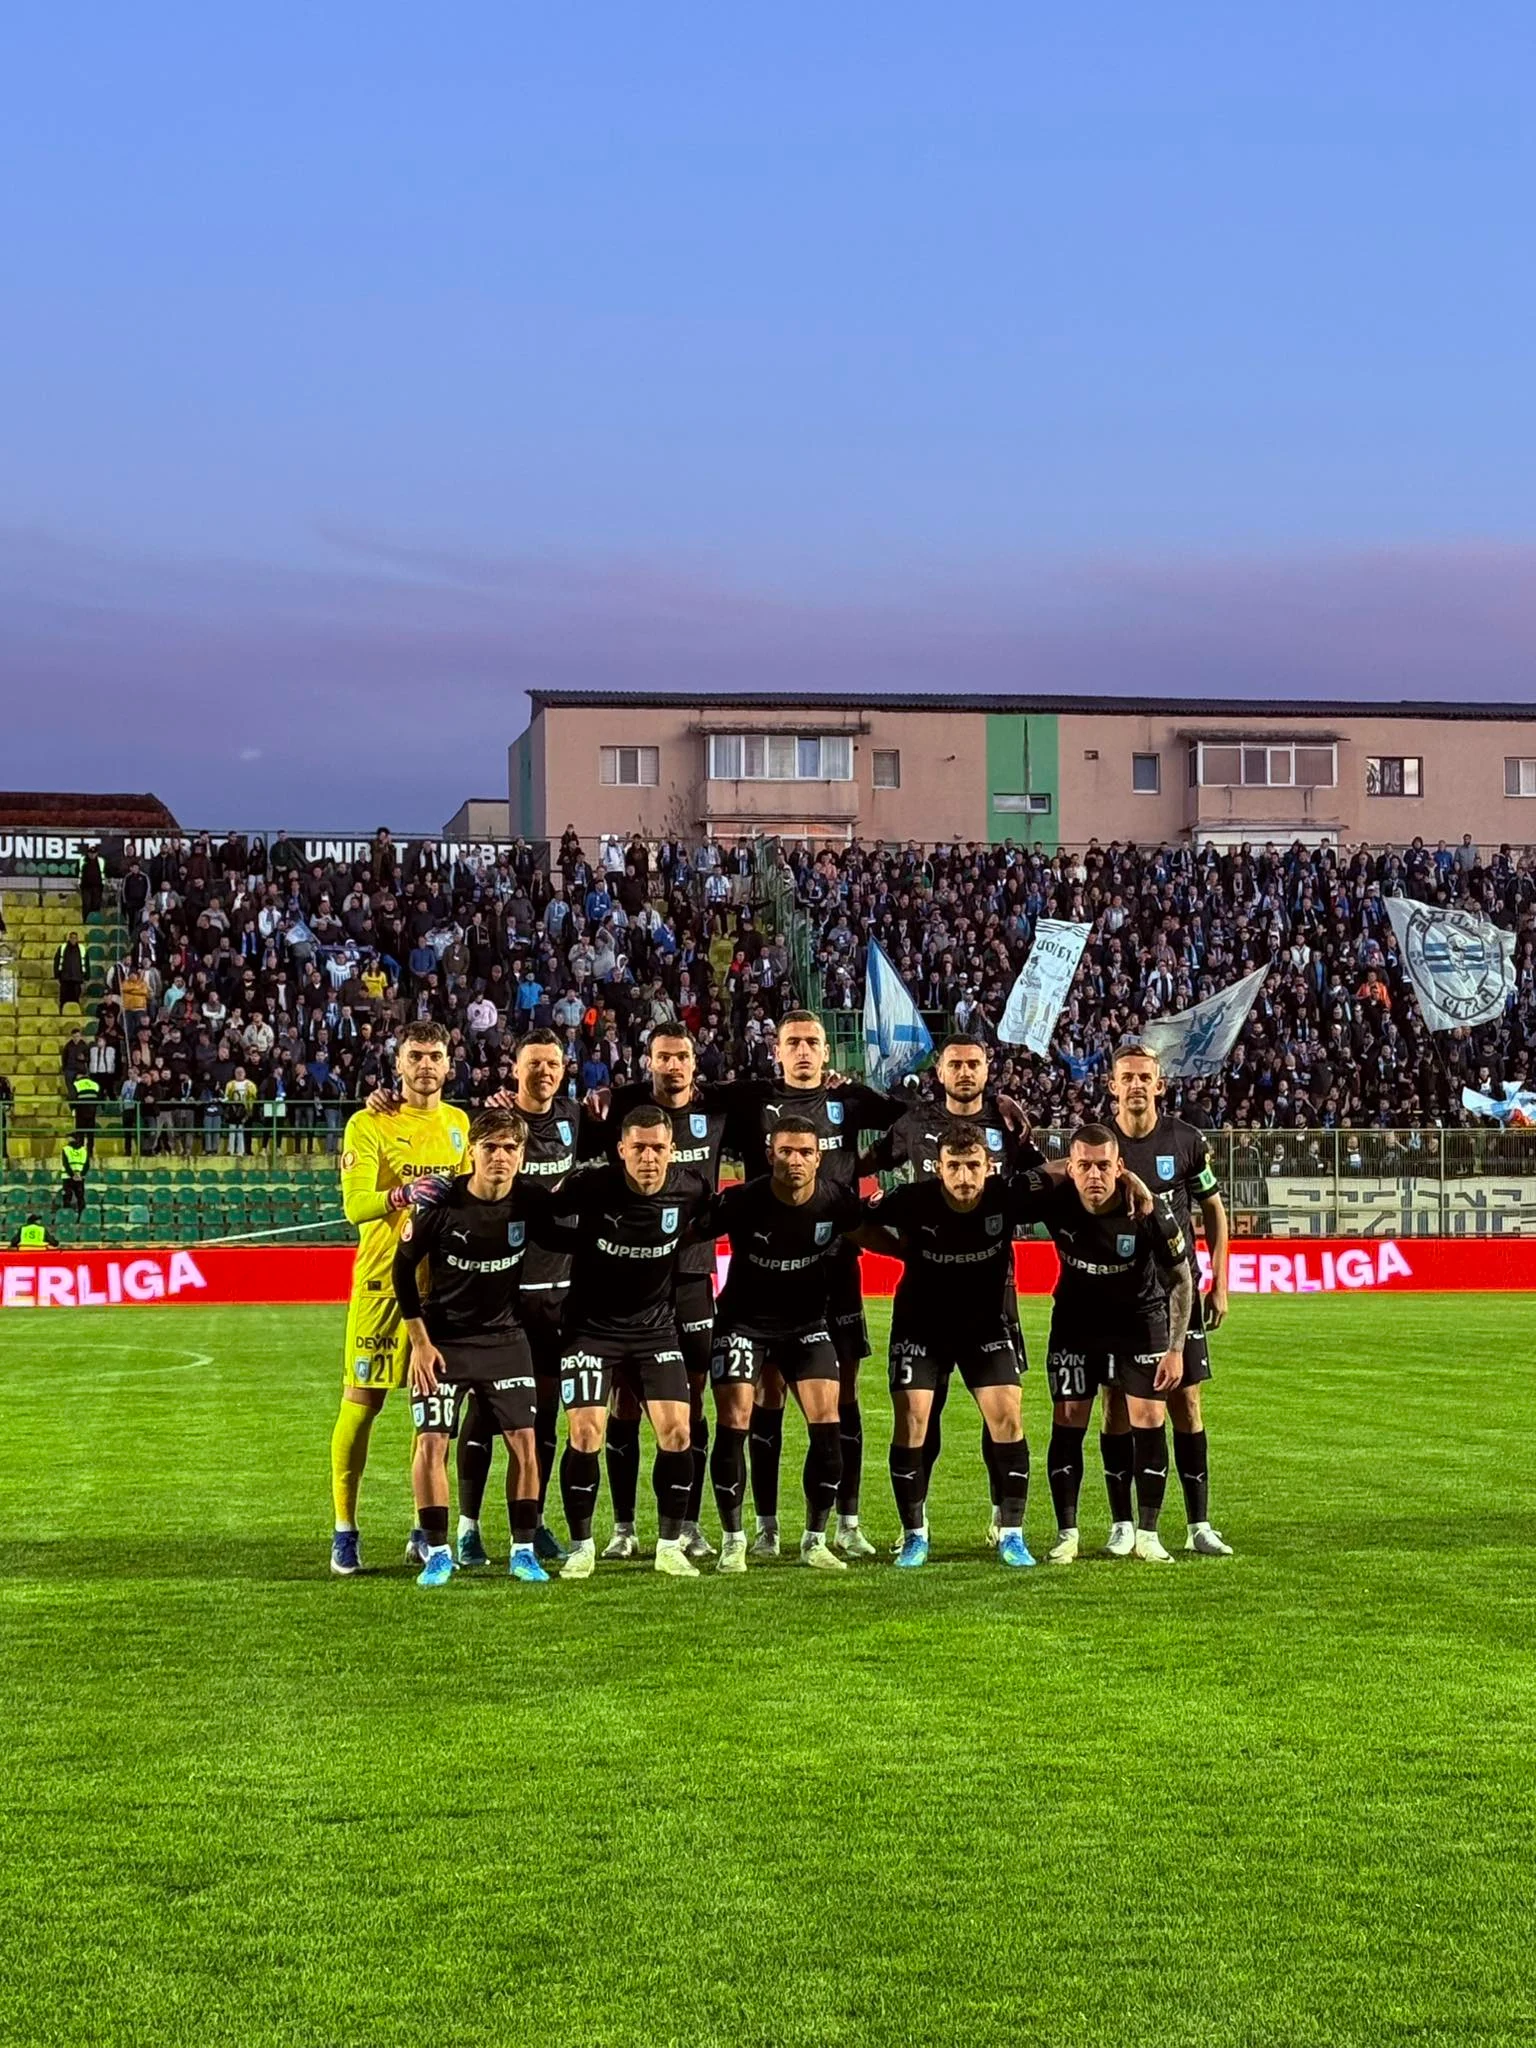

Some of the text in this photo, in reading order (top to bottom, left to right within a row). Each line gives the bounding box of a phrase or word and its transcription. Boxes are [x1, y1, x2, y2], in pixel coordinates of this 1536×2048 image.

[305, 841, 409, 864] UNIBT
[447, 1248, 526, 1273] SUPERBET
[597, 1238, 679, 1259] SUPERBET
[921, 1240, 1003, 1264] SUPERBET
[0, 1251, 207, 1306] ERLIGA
[356, 1333, 399, 1350] DEVIN
[713, 1333, 752, 1350] DEVIN
[374, 1353, 394, 1383] 21
[561, 1351, 603, 1371] DEVIN
[728, 1350, 754, 1379] 23
[900, 1356, 913, 1384] 5
[579, 1371, 603, 1400] 17
[1059, 1366, 1087, 1395] 20
[427, 1397, 455, 1427] 30
